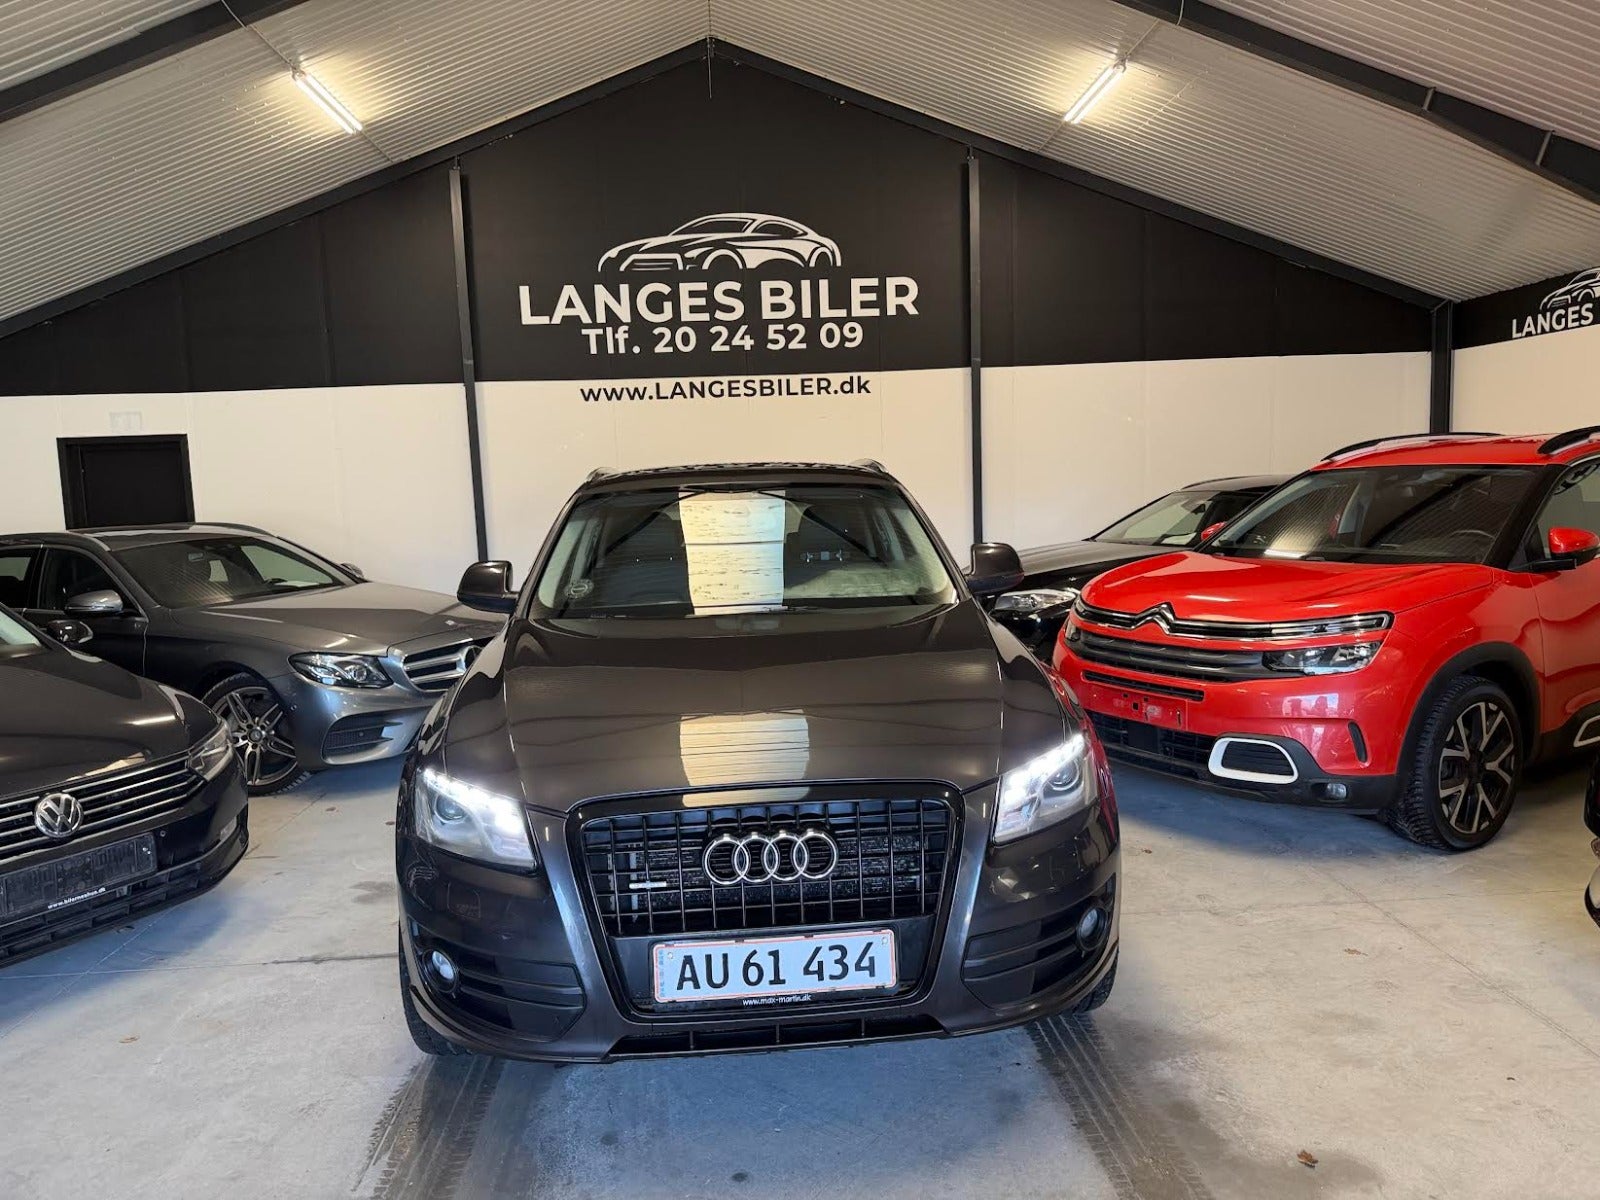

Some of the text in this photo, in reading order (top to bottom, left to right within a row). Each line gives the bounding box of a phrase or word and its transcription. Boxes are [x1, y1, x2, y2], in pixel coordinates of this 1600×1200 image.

[518, 276, 919, 326] LANGES BILER
[581, 321, 864, 355] Tlf. 20 24 52 09
[1511, 303, 1594, 339] LANGES
[579, 376, 871, 402] www.LANGESBILER.dk
[676, 941, 876, 991] AU 61 434
